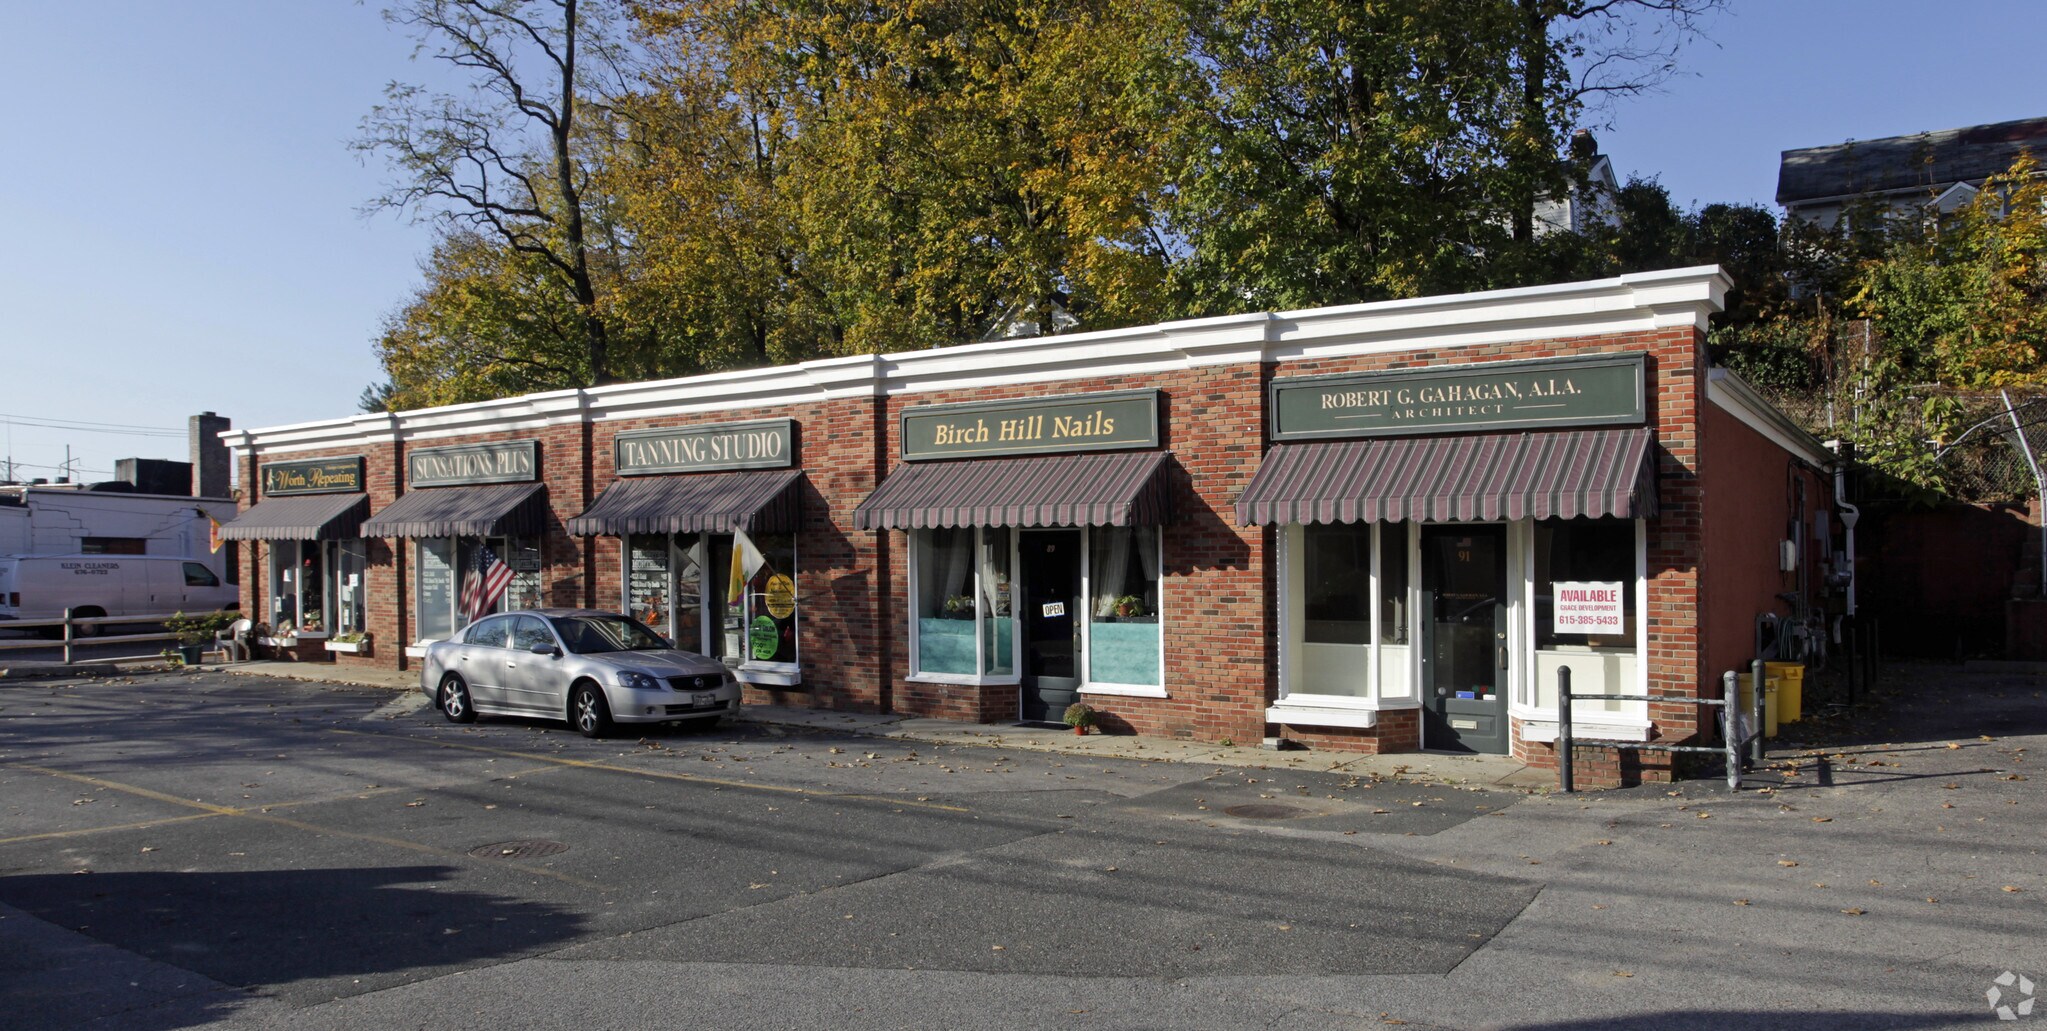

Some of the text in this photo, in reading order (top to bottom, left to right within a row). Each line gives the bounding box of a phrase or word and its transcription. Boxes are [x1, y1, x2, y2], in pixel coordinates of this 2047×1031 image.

[1320, 378, 1582, 409] ROBERT G. GAHAGAN, A.I.A.
[1391, 404, 1504, 420] ARCHITECT
[934, 410, 1115, 445] Birch Hill Nails
[625, 431, 782, 466] TANNING STUDIO
[416, 450, 529, 479] SUNSATIONS PLUS
[275, 467, 355, 489] Worth Repeating
[1458, 550, 1470, 562] 91
[60, 562, 120, 570] KLEIN CLEANERS
[1560, 589, 1617, 602] AVAILABLE
[1044, 604, 1063, 615] OPEN
[1578, 604, 1616, 612] DEVELOPMENT
[1559, 615, 1618, 625] 615-385-5433
